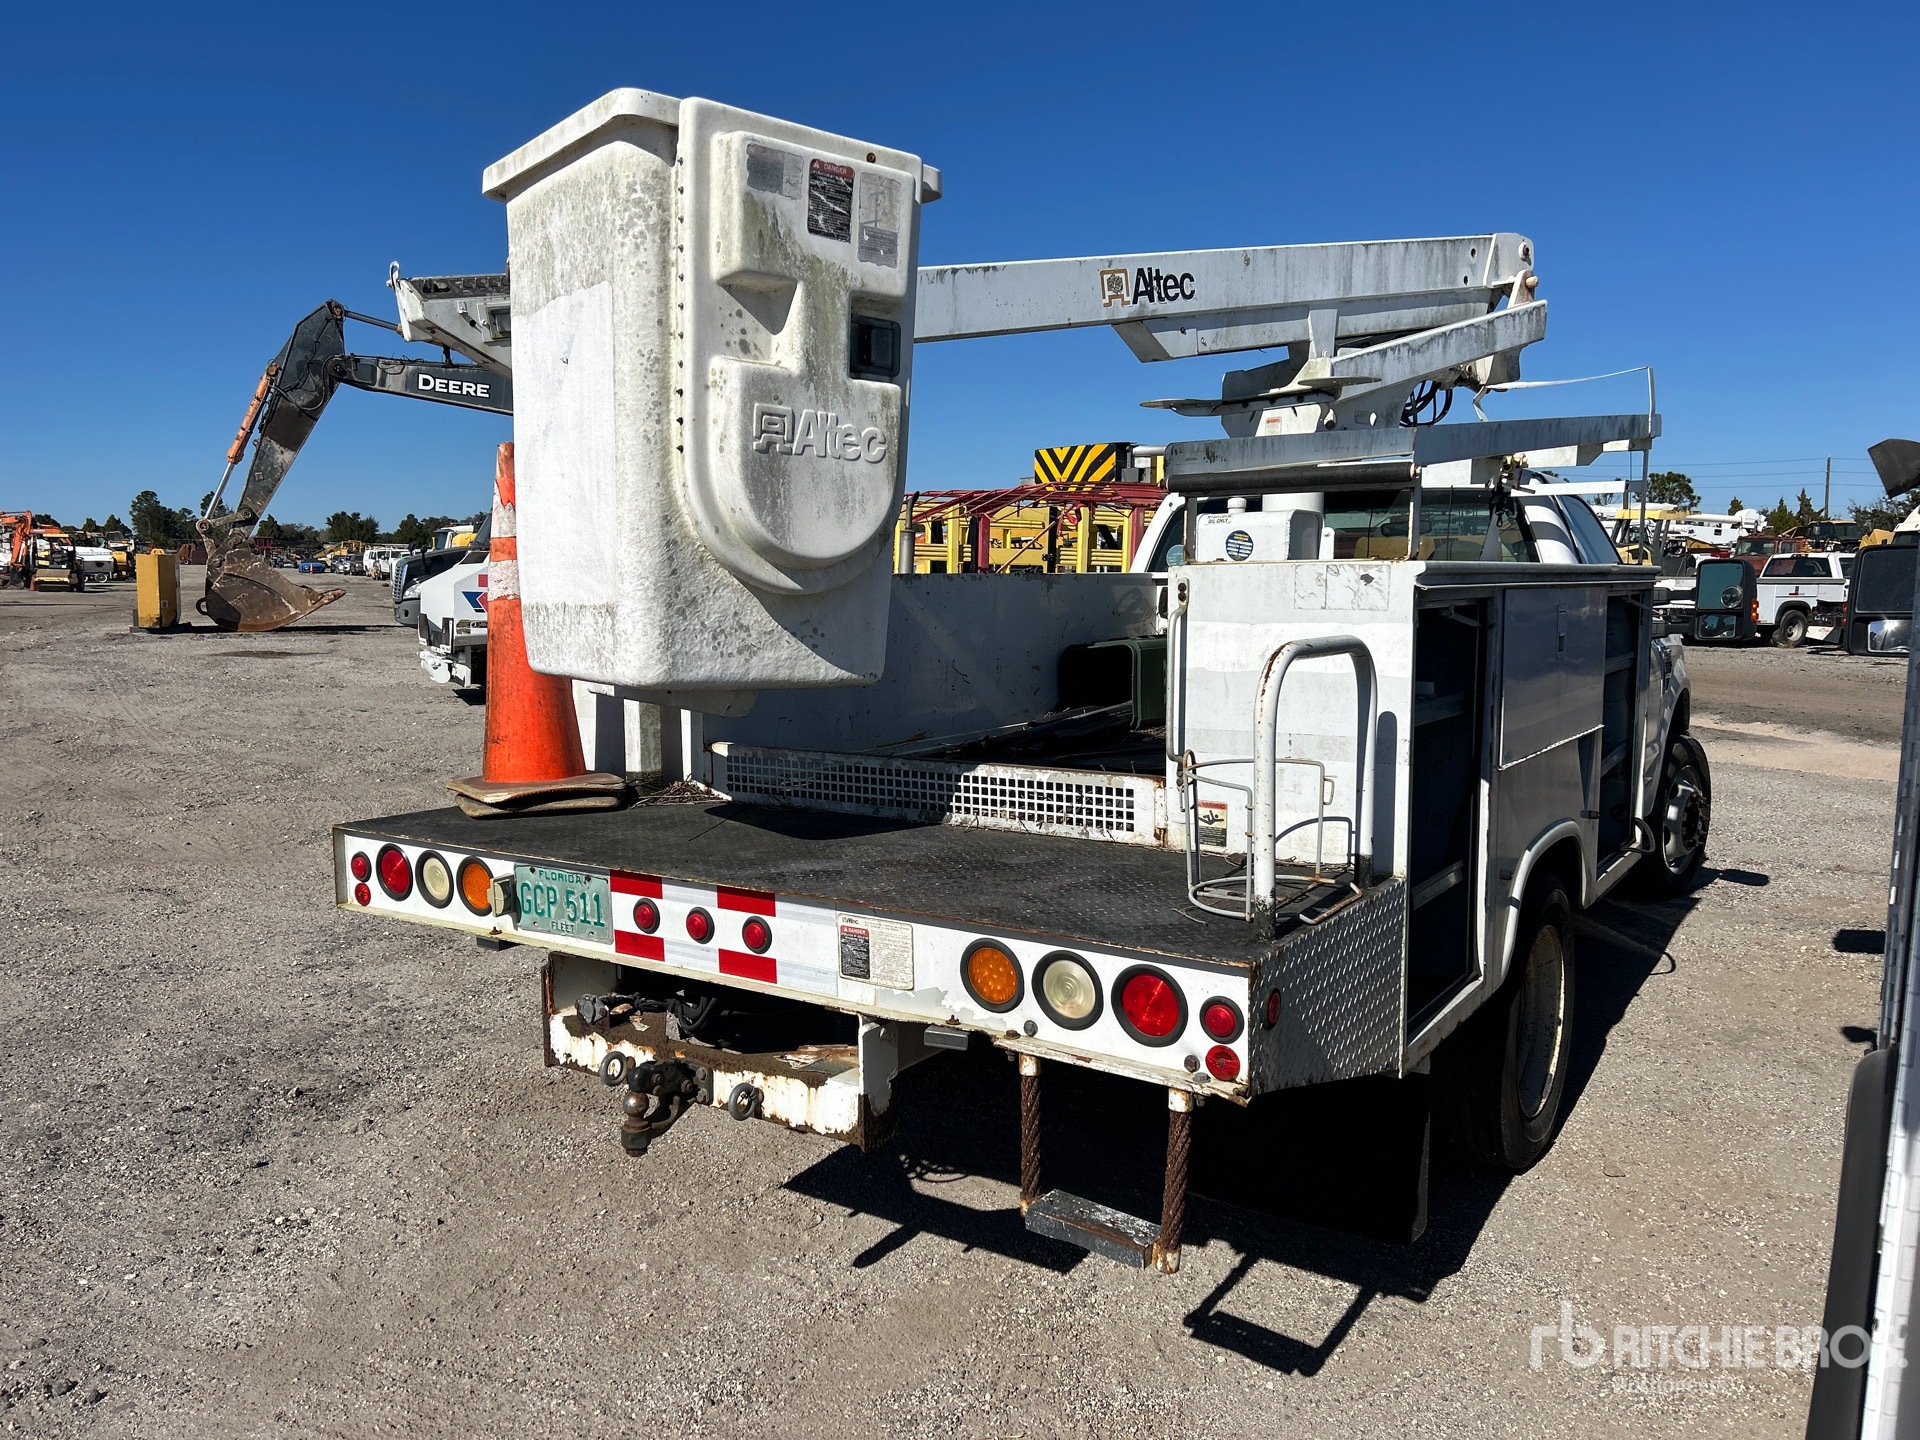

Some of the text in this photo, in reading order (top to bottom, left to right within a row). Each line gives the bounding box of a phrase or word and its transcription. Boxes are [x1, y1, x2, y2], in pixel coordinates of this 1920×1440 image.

[824, 164, 847, 174] DANGER
[1132, 266, 1196, 305] Altec
[419, 374, 489, 397] DEERE
[793, 409, 886, 464] Altec
[539, 870, 582, 884] FLORIDA
[520, 882, 606, 928] GCP 511
[551, 921, 575, 933] FLEET
